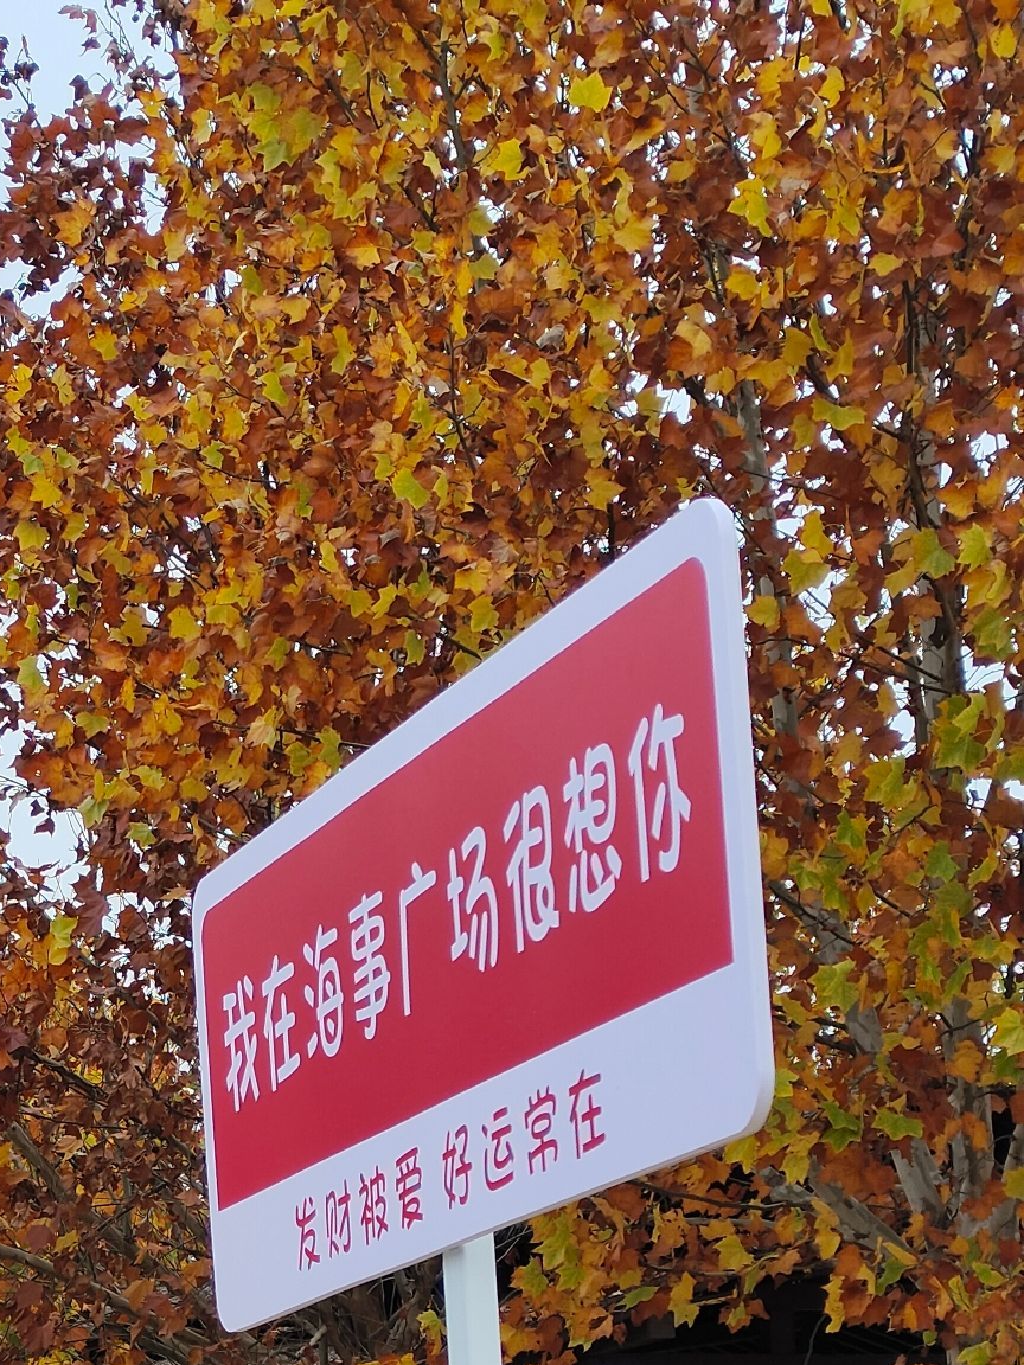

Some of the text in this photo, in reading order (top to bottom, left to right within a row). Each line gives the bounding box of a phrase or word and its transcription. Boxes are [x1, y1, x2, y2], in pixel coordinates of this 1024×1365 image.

[223, 703, 692, 1112] 我在海事广场很想你
[294, 1070, 607, 1272] 发财被爱 好运常在
